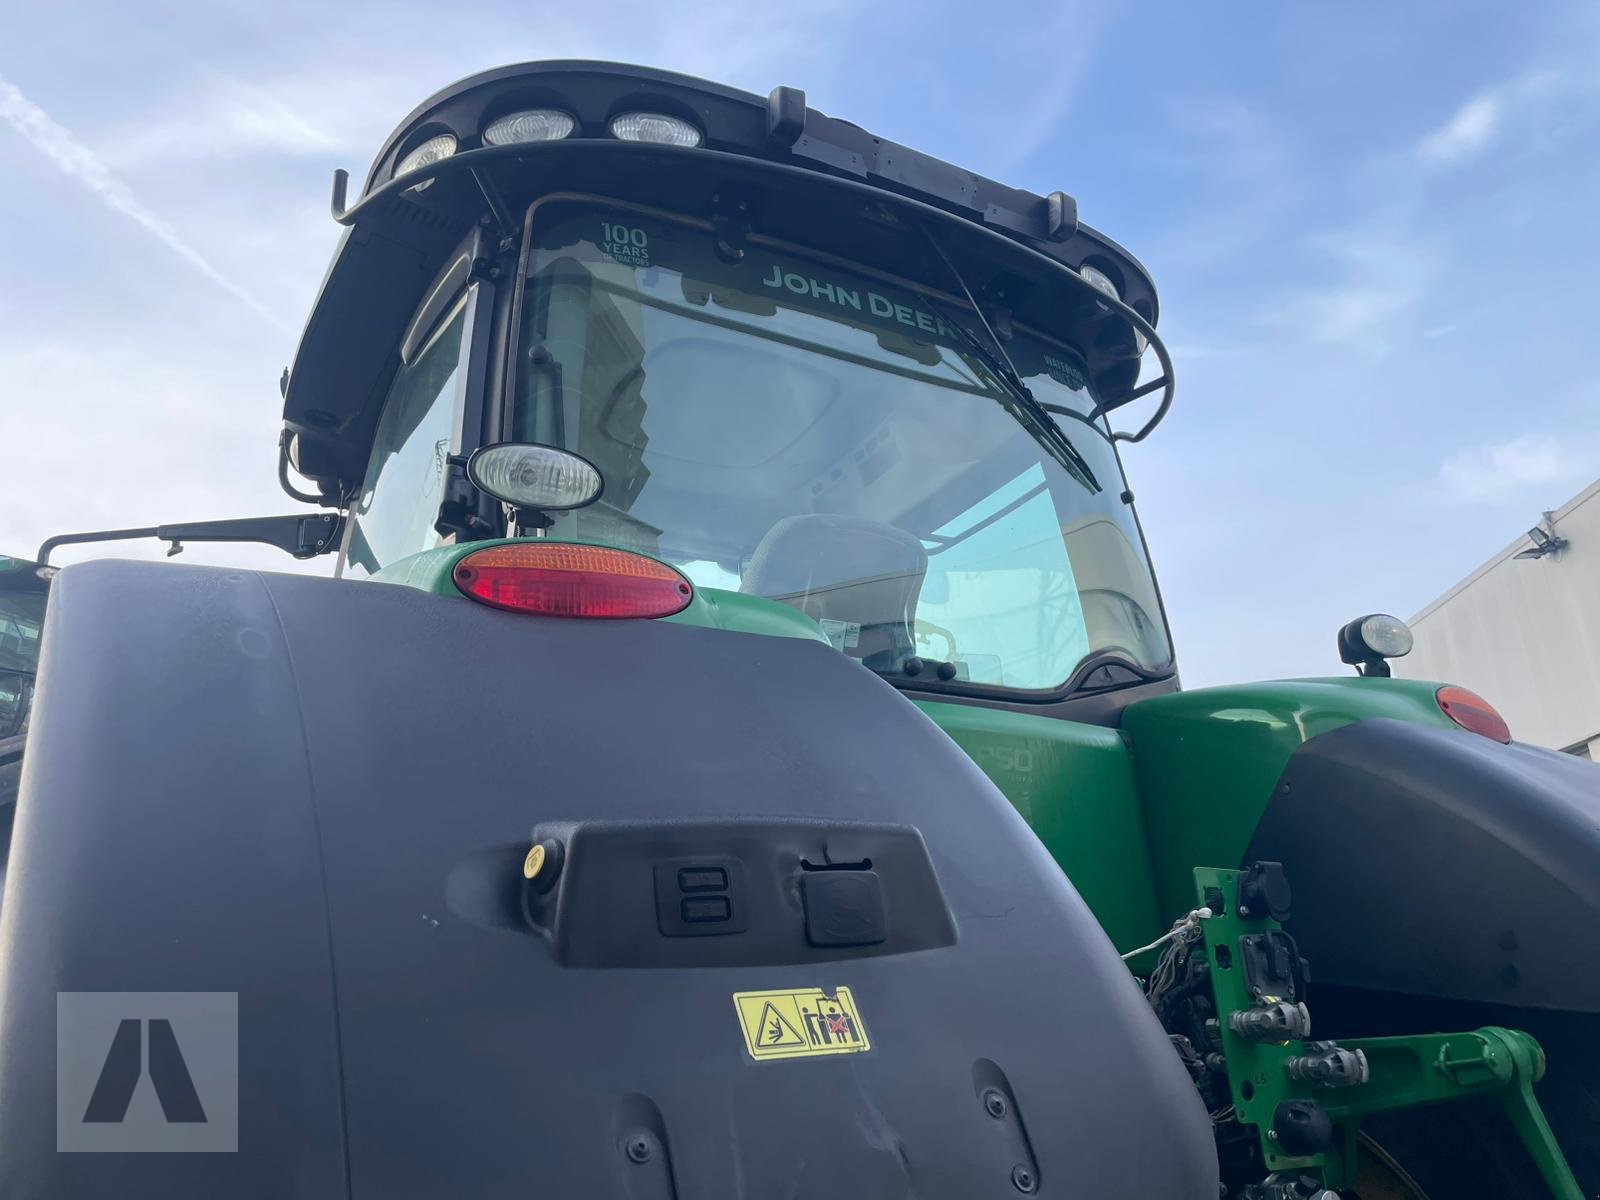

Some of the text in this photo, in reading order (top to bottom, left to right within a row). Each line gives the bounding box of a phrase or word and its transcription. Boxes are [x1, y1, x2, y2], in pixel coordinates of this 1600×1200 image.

[601, 222, 648, 248] 100
[603, 242, 649, 259] YEARS
[615, 254, 649, 267] TRACTORS
[763, 265, 978, 344] JOHN DEER
